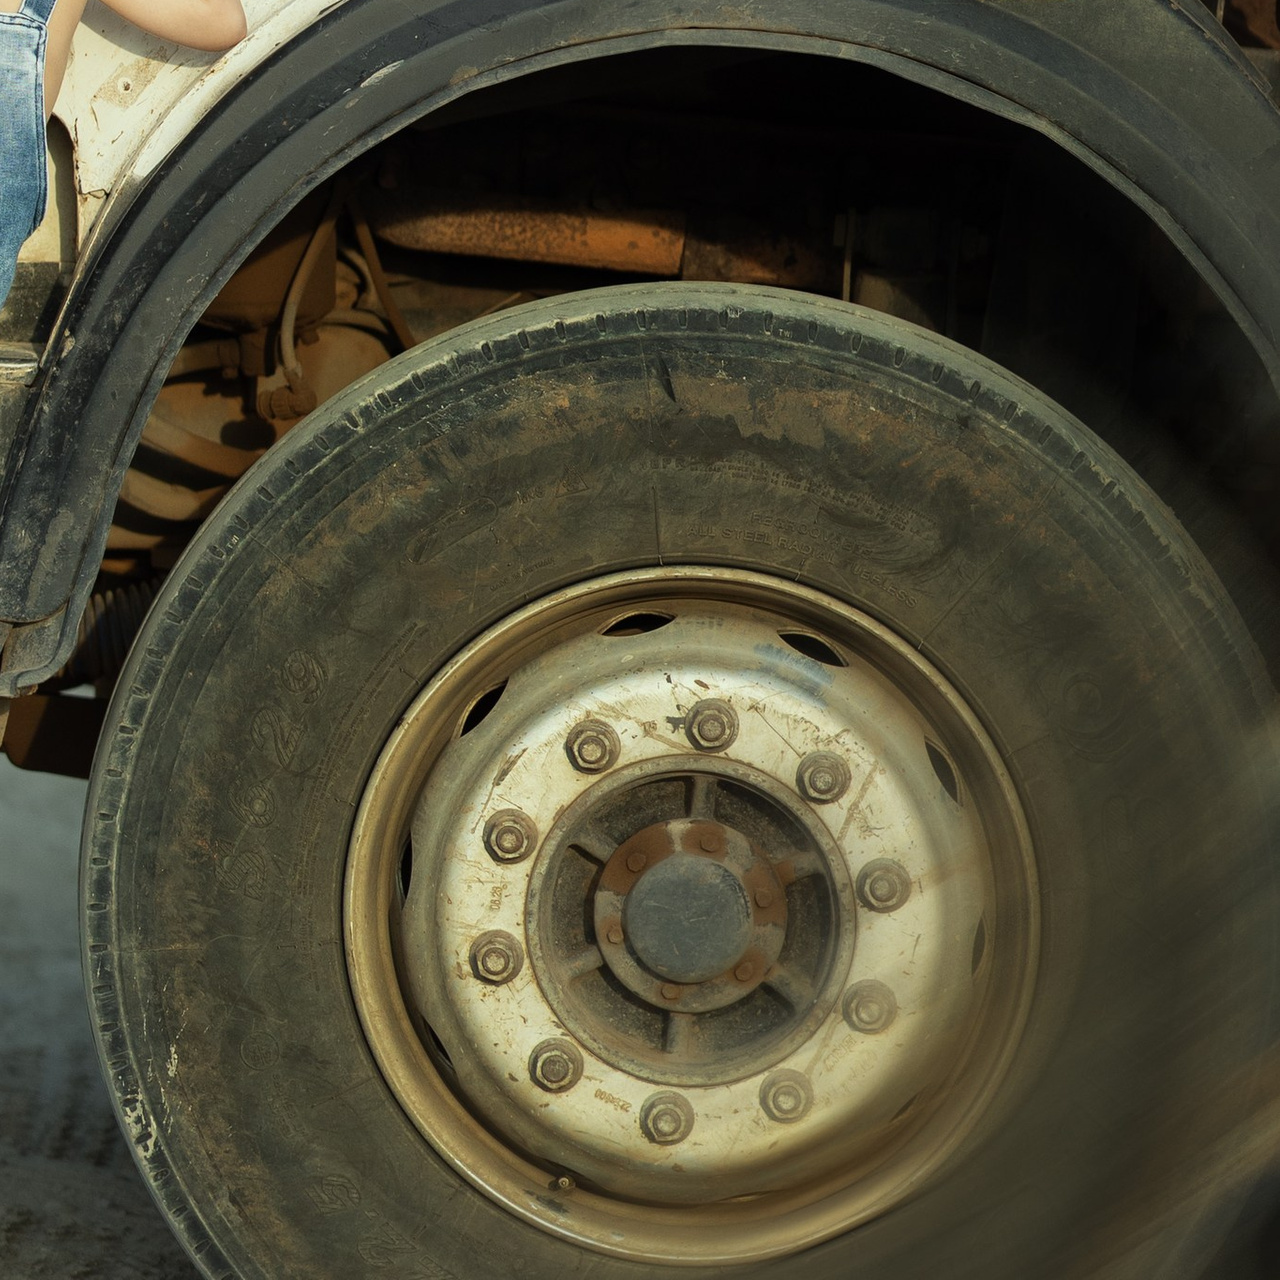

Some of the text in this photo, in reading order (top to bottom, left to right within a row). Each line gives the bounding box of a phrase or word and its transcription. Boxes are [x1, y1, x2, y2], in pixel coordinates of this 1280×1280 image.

[686, 524, 716, 539] ALL
[721, 527, 773, 547] STEEL
[776, 536, 836, 566] RADIAL
[750, 512, 873, 560] REGROOVABLE
